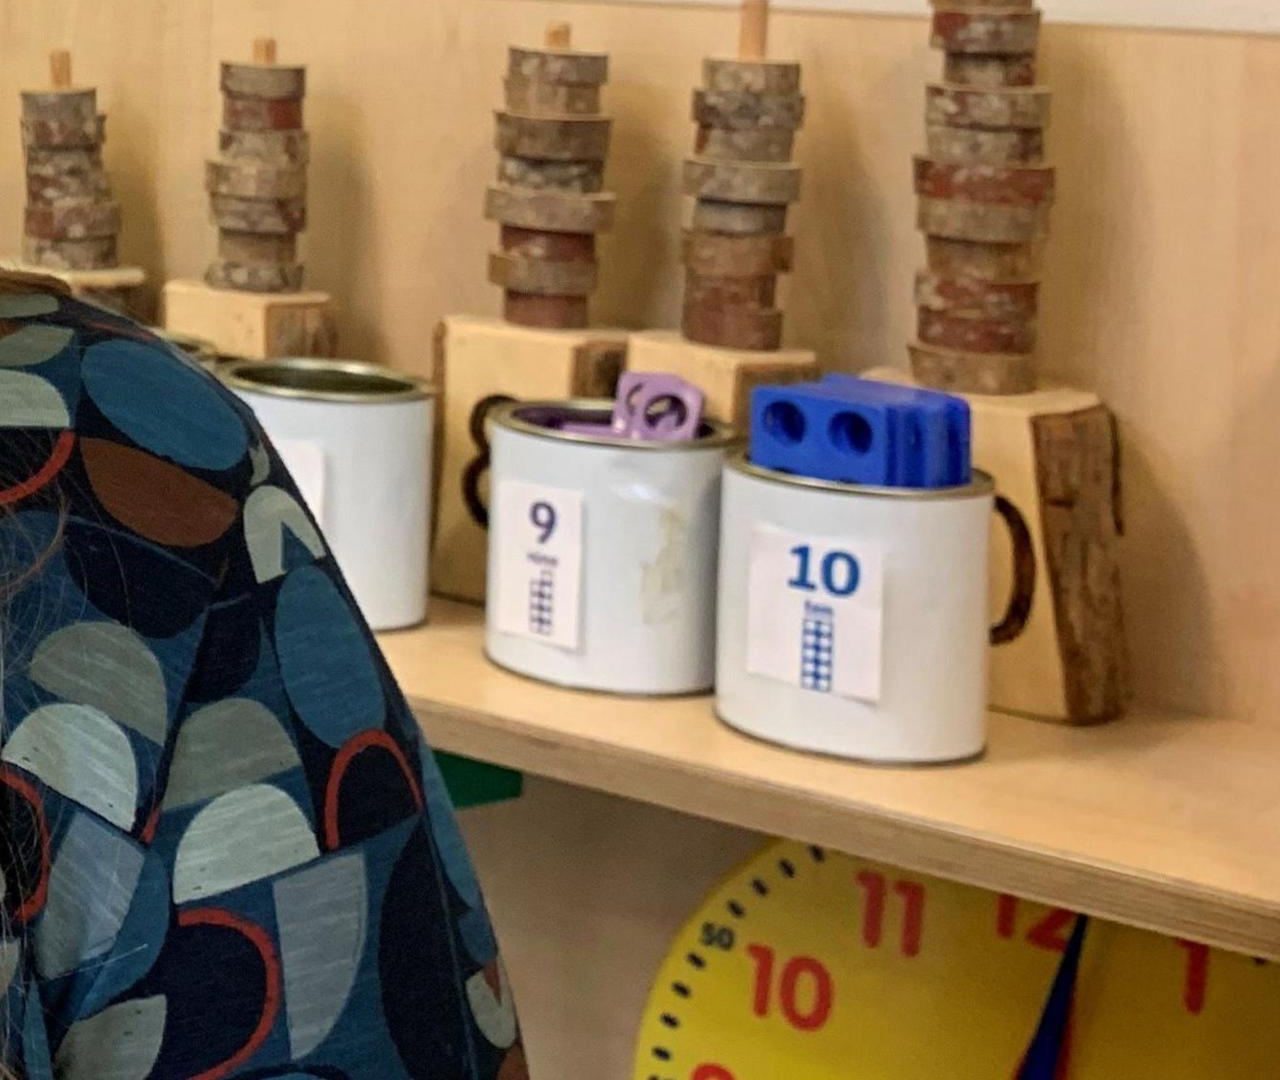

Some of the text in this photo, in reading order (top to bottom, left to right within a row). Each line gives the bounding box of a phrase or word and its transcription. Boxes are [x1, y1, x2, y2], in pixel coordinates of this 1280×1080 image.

[529, 500, 558, 545] 9
[788, 543, 861, 598] 10
[700, 921, 735, 952] 50
[856, 871, 926, 958] 11
[746, 942, 834, 1032] 10
